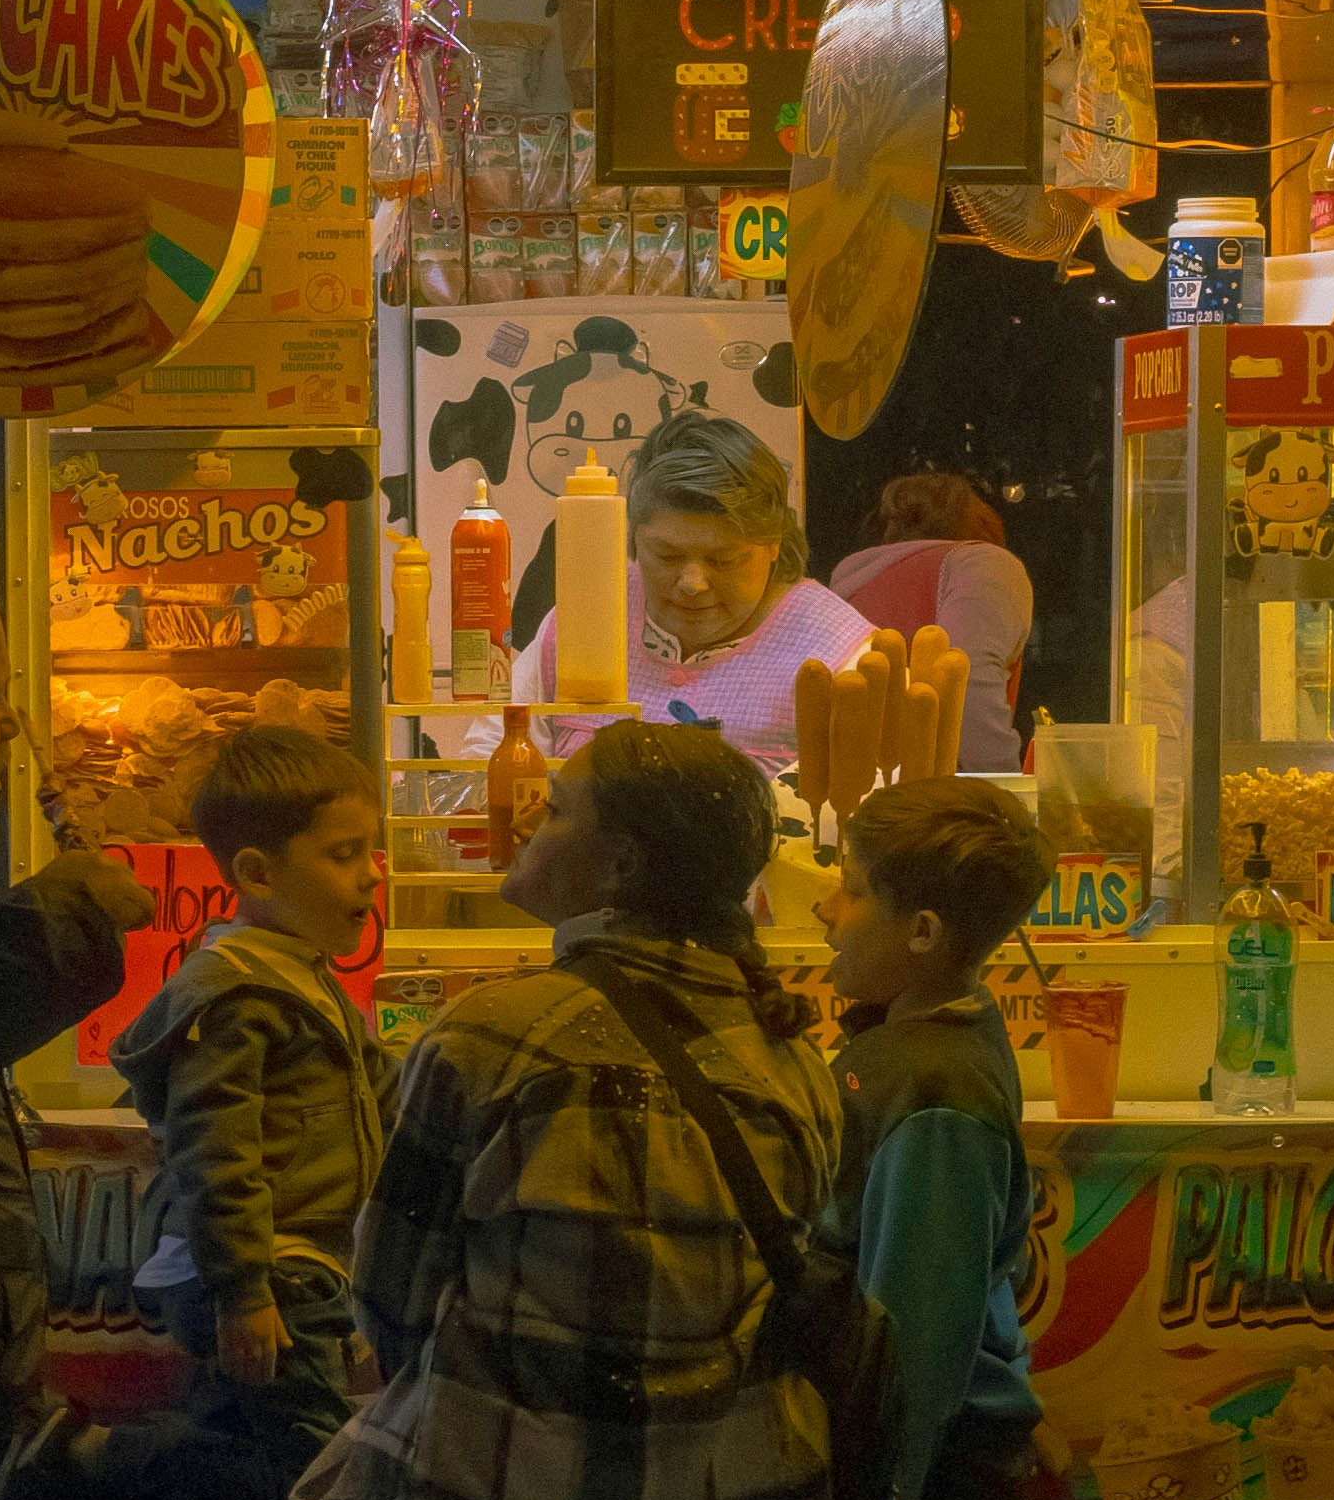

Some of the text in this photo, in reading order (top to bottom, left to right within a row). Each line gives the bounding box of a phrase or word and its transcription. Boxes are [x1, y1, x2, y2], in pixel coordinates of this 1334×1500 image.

[297, 251, 336, 261] POLLO
[1133, 346, 1183, 400] POPCORN
[66, 498, 327, 576] Nachos
[1228, 937, 1279, 958] GEL
